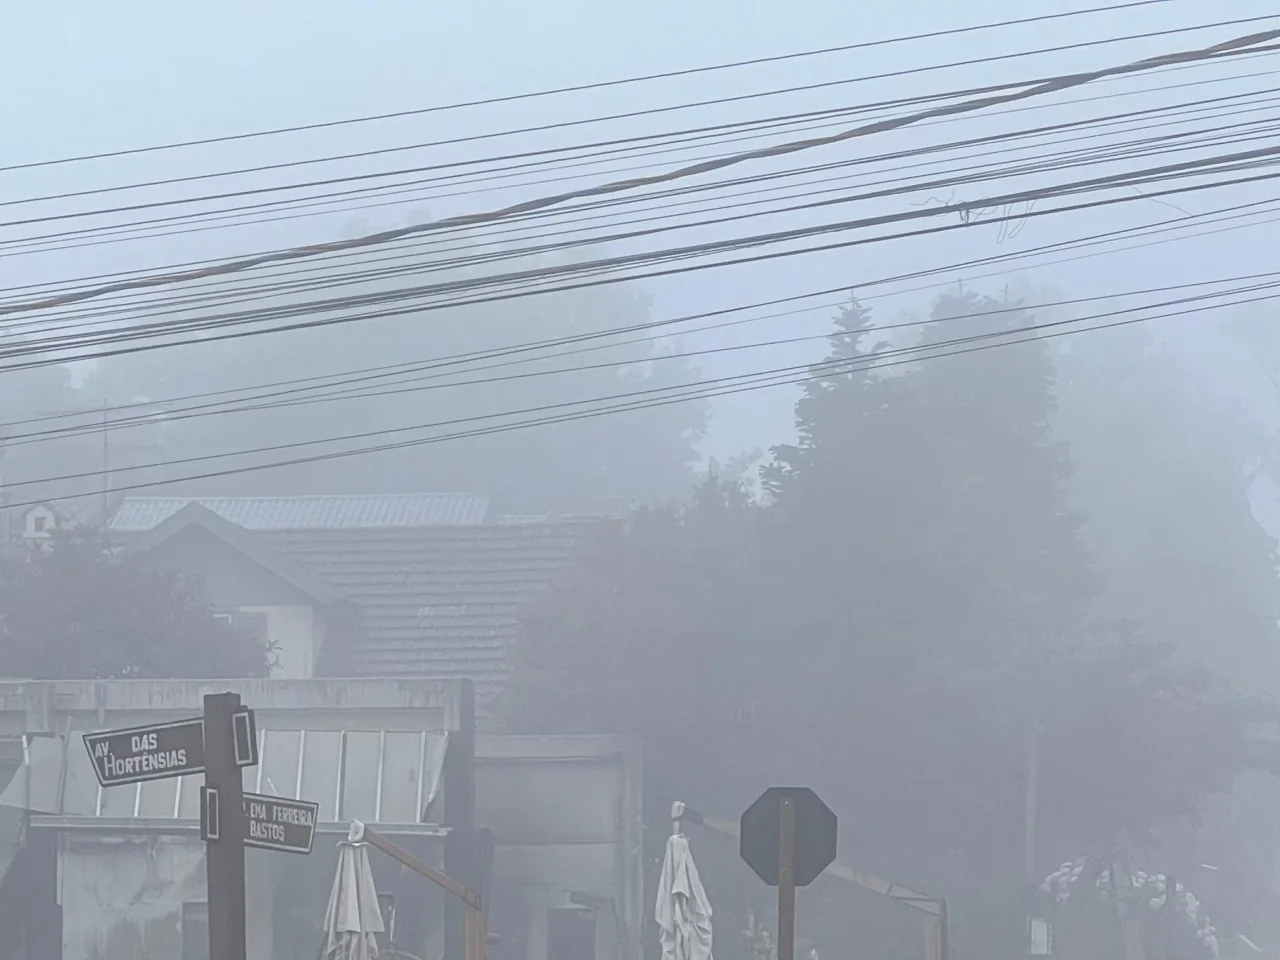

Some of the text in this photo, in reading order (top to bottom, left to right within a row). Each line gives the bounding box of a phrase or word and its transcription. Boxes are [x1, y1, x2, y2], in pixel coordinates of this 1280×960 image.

[95, 733, 158, 758] AV. DAS
[103, 749, 187, 776] HORTÊNSIAS
[272, 805, 313, 826] FERREIRA
[249, 820, 285, 842] BASTOS
